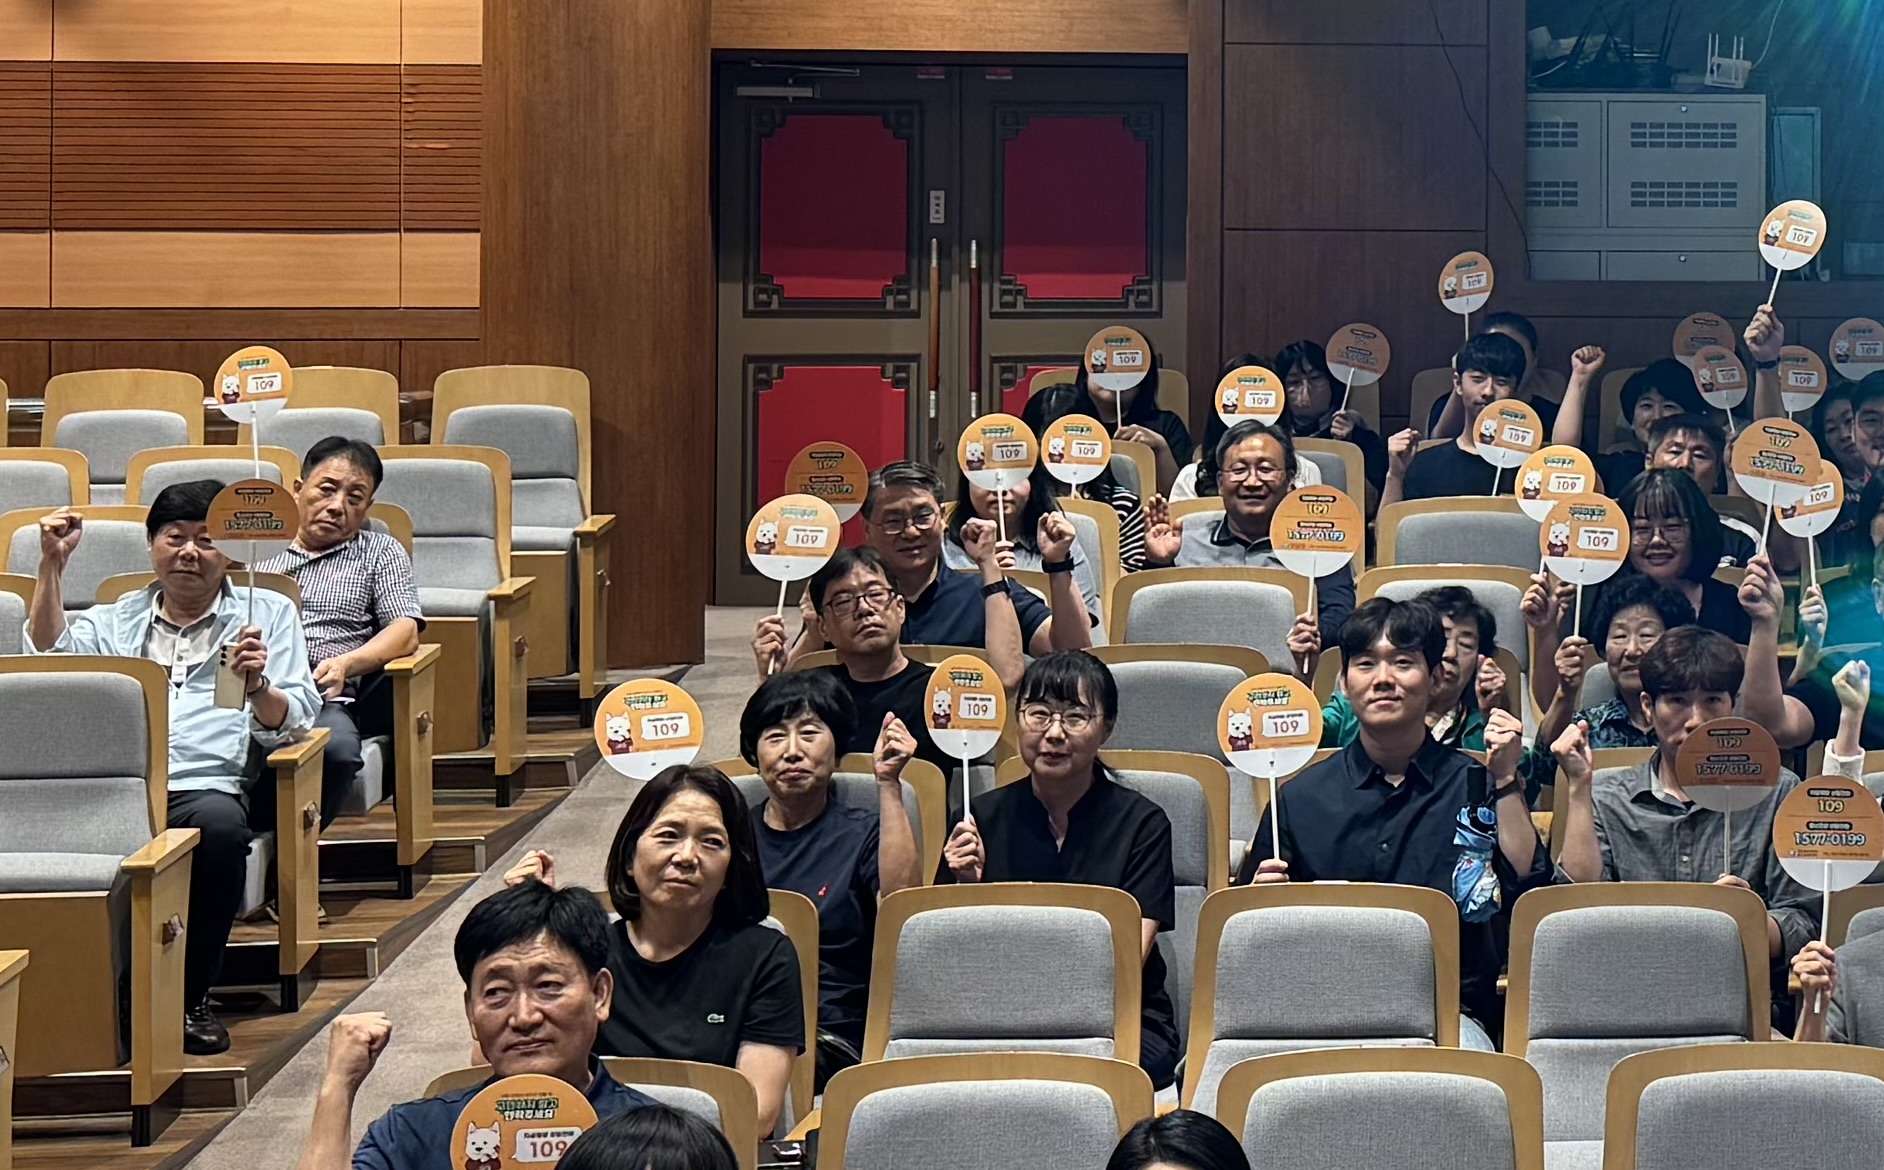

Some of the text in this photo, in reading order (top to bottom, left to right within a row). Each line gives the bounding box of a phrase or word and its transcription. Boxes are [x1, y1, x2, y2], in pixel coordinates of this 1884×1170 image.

[1120, 356, 1136, 364] 109
[1252, 397, 1269, 405] 109
[1510, 432, 1526, 441] 109
[1000, 449, 1020, 458] 109
[1079, 447, 1095, 455] 109
[1556, 480, 1576, 490] 109
[795, 533, 818, 544] 109
[1586, 535, 1609, 547] 109
[968, 703, 988, 716] 109
[652, 722, 680, 736] 109
[1272, 719, 1299, 733] 109
[1818, 799, 1845, 813] 109
[1794, 832, 1866, 846] 1577-0199
[530, 1141, 568, 1158] 109
